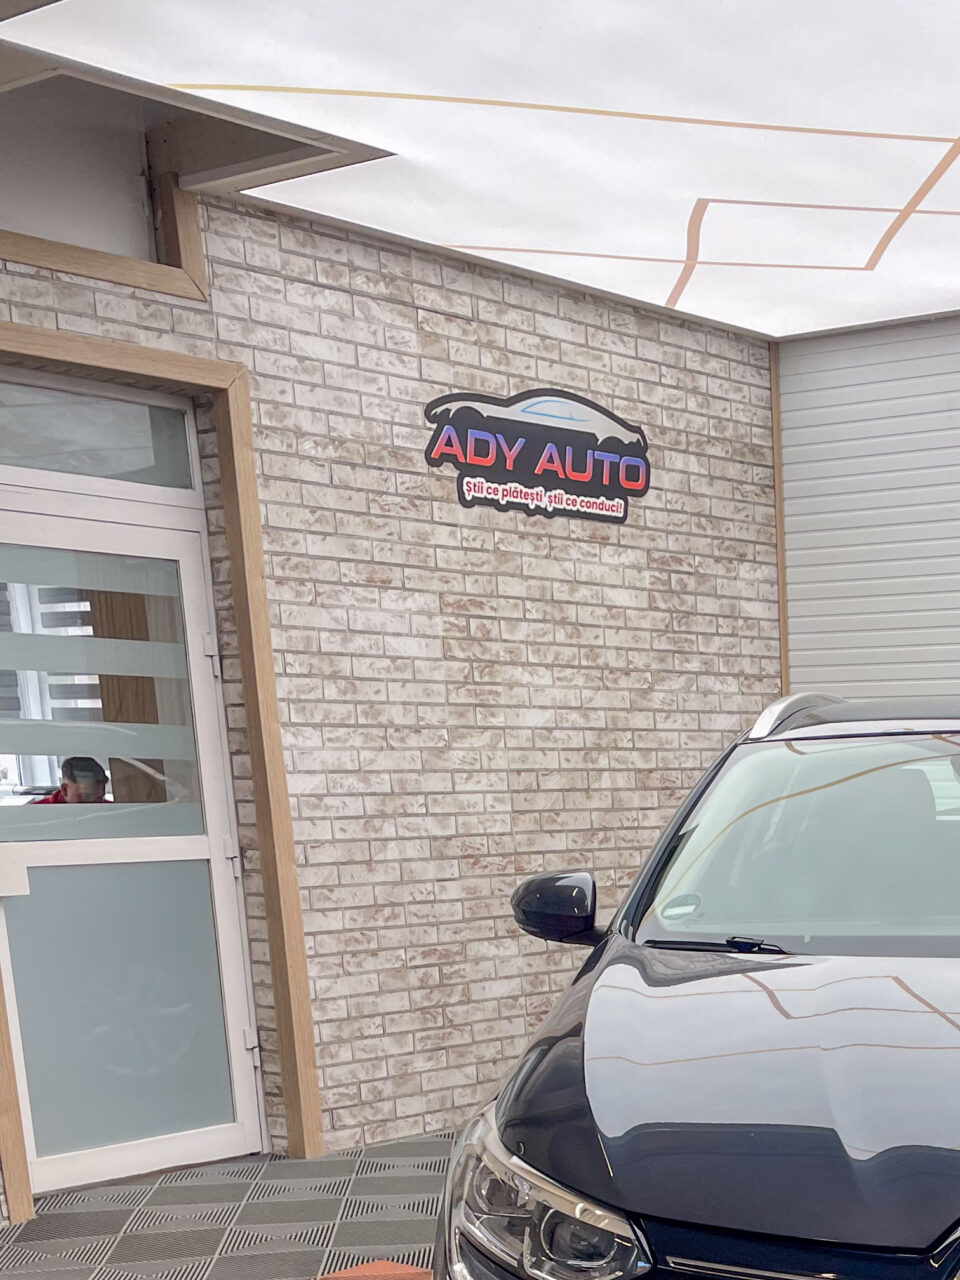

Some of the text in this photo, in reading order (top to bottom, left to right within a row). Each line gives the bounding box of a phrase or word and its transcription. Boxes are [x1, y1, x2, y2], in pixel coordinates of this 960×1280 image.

[431, 424, 646, 490] ADY AUTO
[486, 485, 499, 496] ce
[565, 496, 578, 508] ce
[580, 498, 623, 514] conduci!
